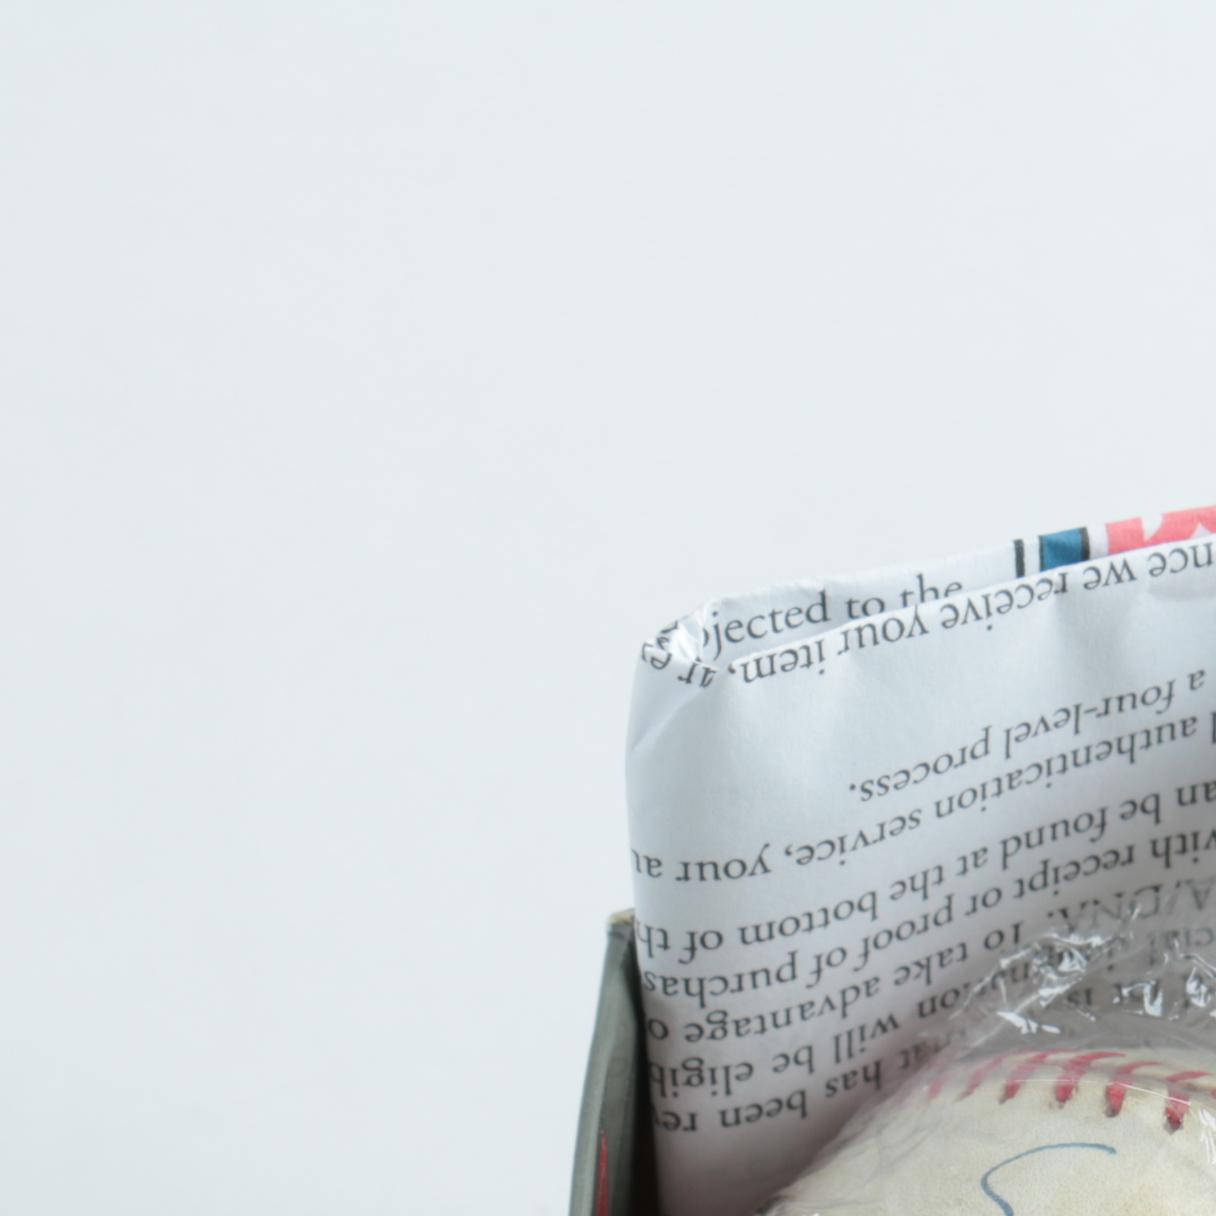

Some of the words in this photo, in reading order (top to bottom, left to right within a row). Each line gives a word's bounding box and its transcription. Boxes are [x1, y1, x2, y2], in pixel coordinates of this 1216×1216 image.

[844, 596, 886, 620] to
[899, 572, 963, 609] the
[1081, 557, 1137, 592] we
[938, 571, 1071, 632] receive
[835, 603, 930, 656] your
[726, 638, 827, 685] item,
[1186, 669, 1207, 692] a
[1002, 677, 1176, 761] four-level
[848, 725, 992, 804] process.
[932, 714, 1200, 821] authentication
[1118, 792, 1162, 826] be
[674, 841, 772, 883] your
[782, 807, 923, 869] service,
[998, 806, 1110, 872] found
[888, 863, 945, 902] the
[954, 846, 989, 880] at
[1012, 843, 1136, 901] receipt
[736, 889, 879, 947] bottom
[963, 885, 1005, 918] or
[676, 929, 724, 966] of
[852, 892, 956, 972] proof
[804, 945, 848, 990] of
[892, 940, 968, 988] take
[683, 975, 881, 1044] advantage
[772, 1044, 815, 1076] be
[833, 1013, 900, 1065] will
[824, 1060, 882, 1099] has
[718, 1089, 809, 1129] been
